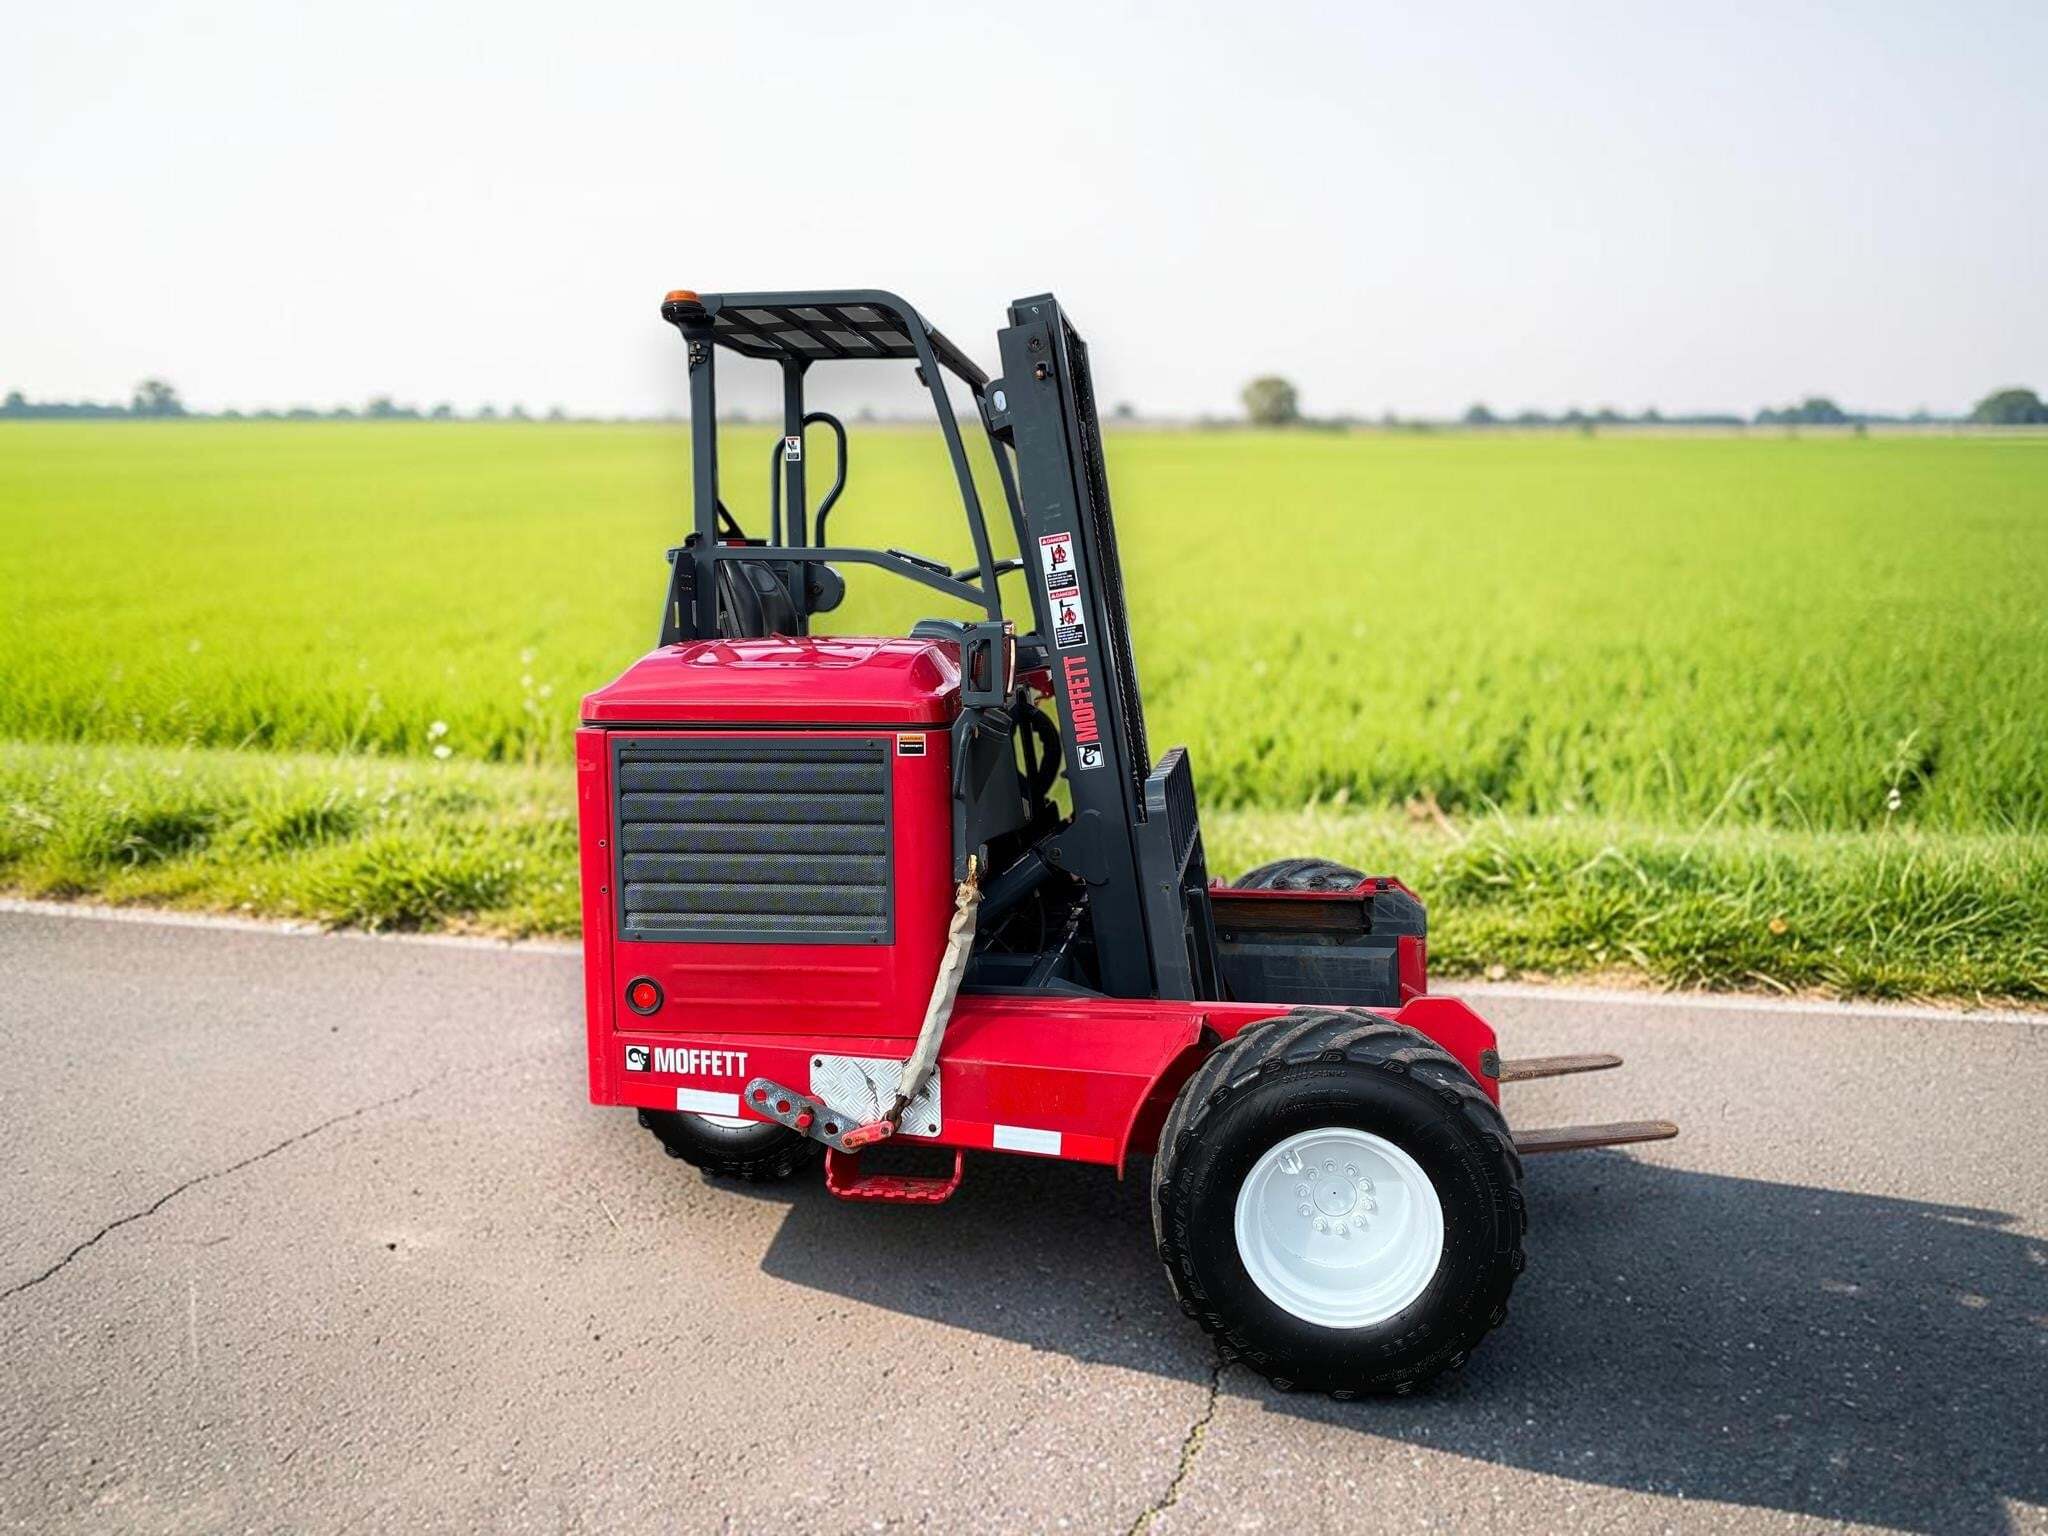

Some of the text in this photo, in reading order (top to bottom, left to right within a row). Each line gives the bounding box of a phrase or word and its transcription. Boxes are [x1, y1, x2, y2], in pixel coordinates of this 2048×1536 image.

[1046, 535, 1068, 544] DANGER
[1055, 590, 1078, 599] DANGER
[1063, 656, 1099, 743] MOFFETT
[654, 1047, 748, 1078] MOFFETT
